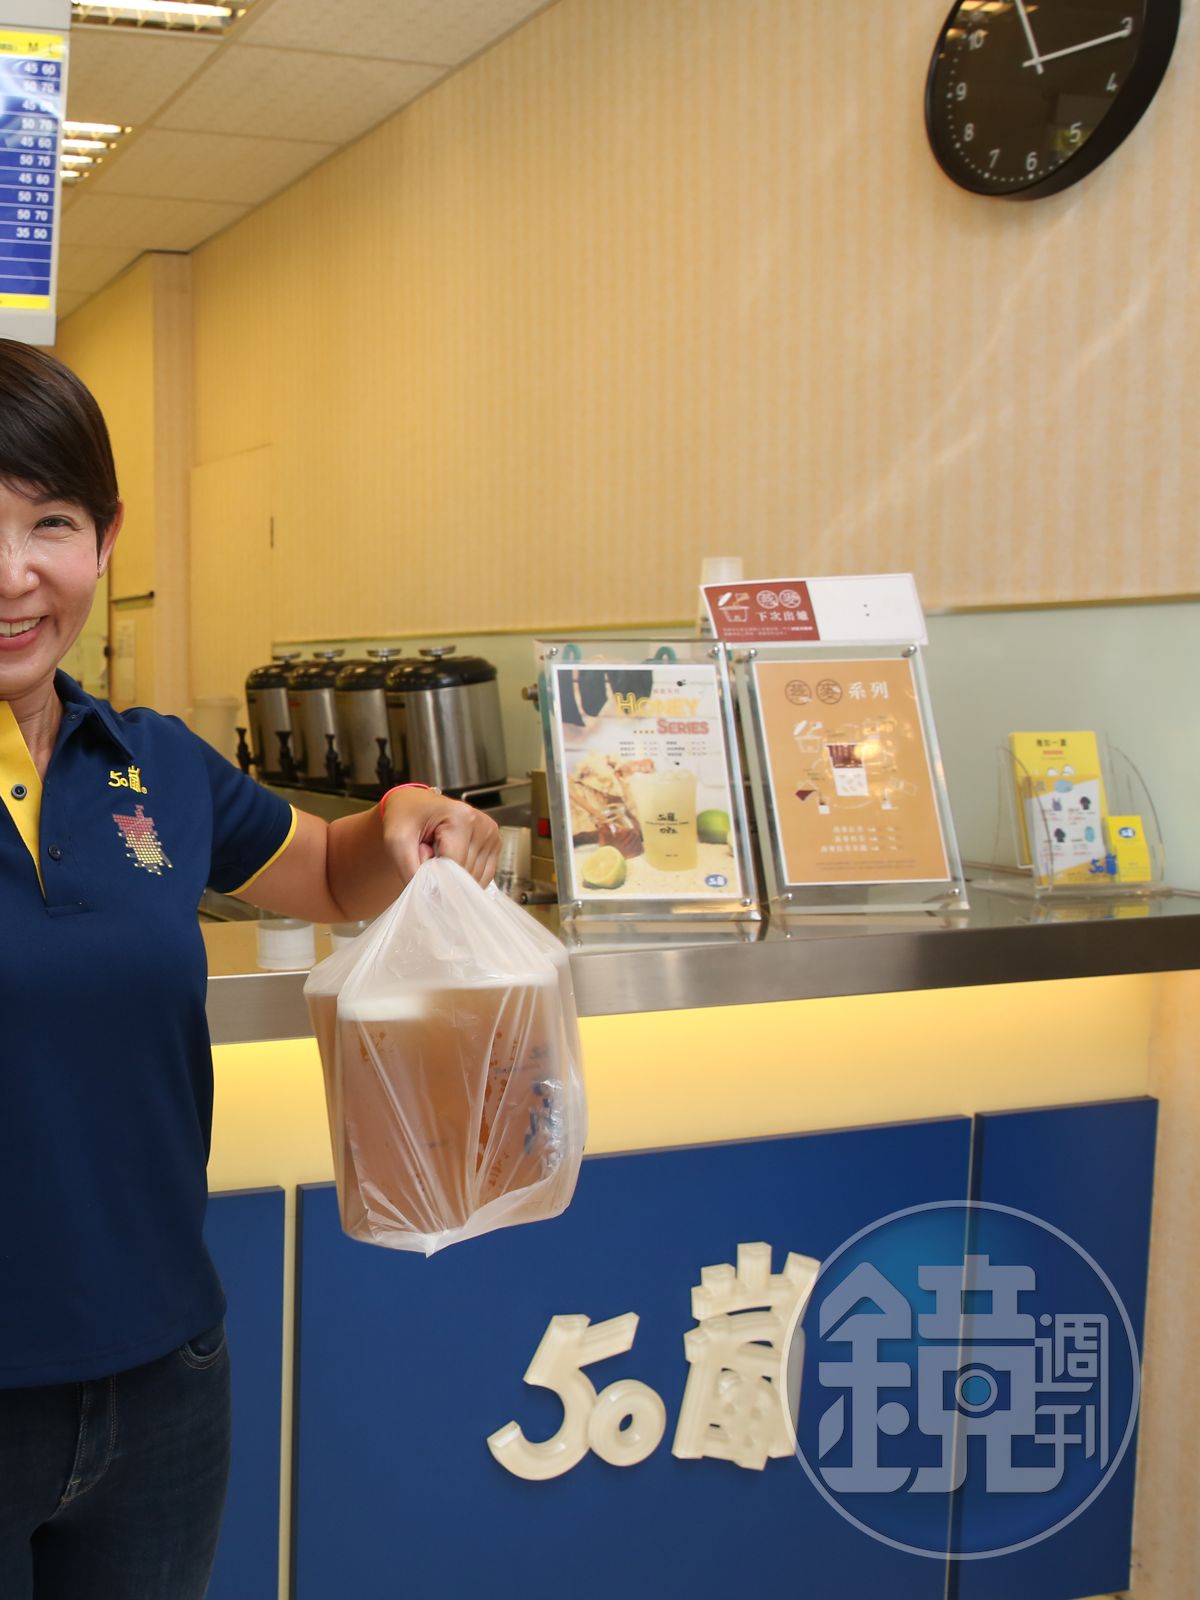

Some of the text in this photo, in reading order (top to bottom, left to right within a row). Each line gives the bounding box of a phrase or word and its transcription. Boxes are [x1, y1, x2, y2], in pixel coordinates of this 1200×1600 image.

[967, 29, 984, 50] 10
[25, 63, 55, 75] 45 60
[1106, 73, 1118, 91] 4
[956, 83, 967, 100] 9
[40, 119, 52, 130] 70
[964, 124, 974, 141] 8
[1069, 123, 1082, 142] 5
[21, 136, 51, 148] 45 60
[20, 155, 33, 165] 50
[38, 155, 50, 166] 70
[989, 149, 1000, 168] 7
[1026, 152, 1037, 171] 6
[19, 173, 32, 184] 45
[36, 174, 49, 185] 60
[18, 191, 31, 202] 50
[36, 192, 49, 203] 70
[17, 209, 30, 220] 50
[35, 210, 48, 221] 70
[16, 228, 29, 238] 35
[34, 228, 47, 239] 50
